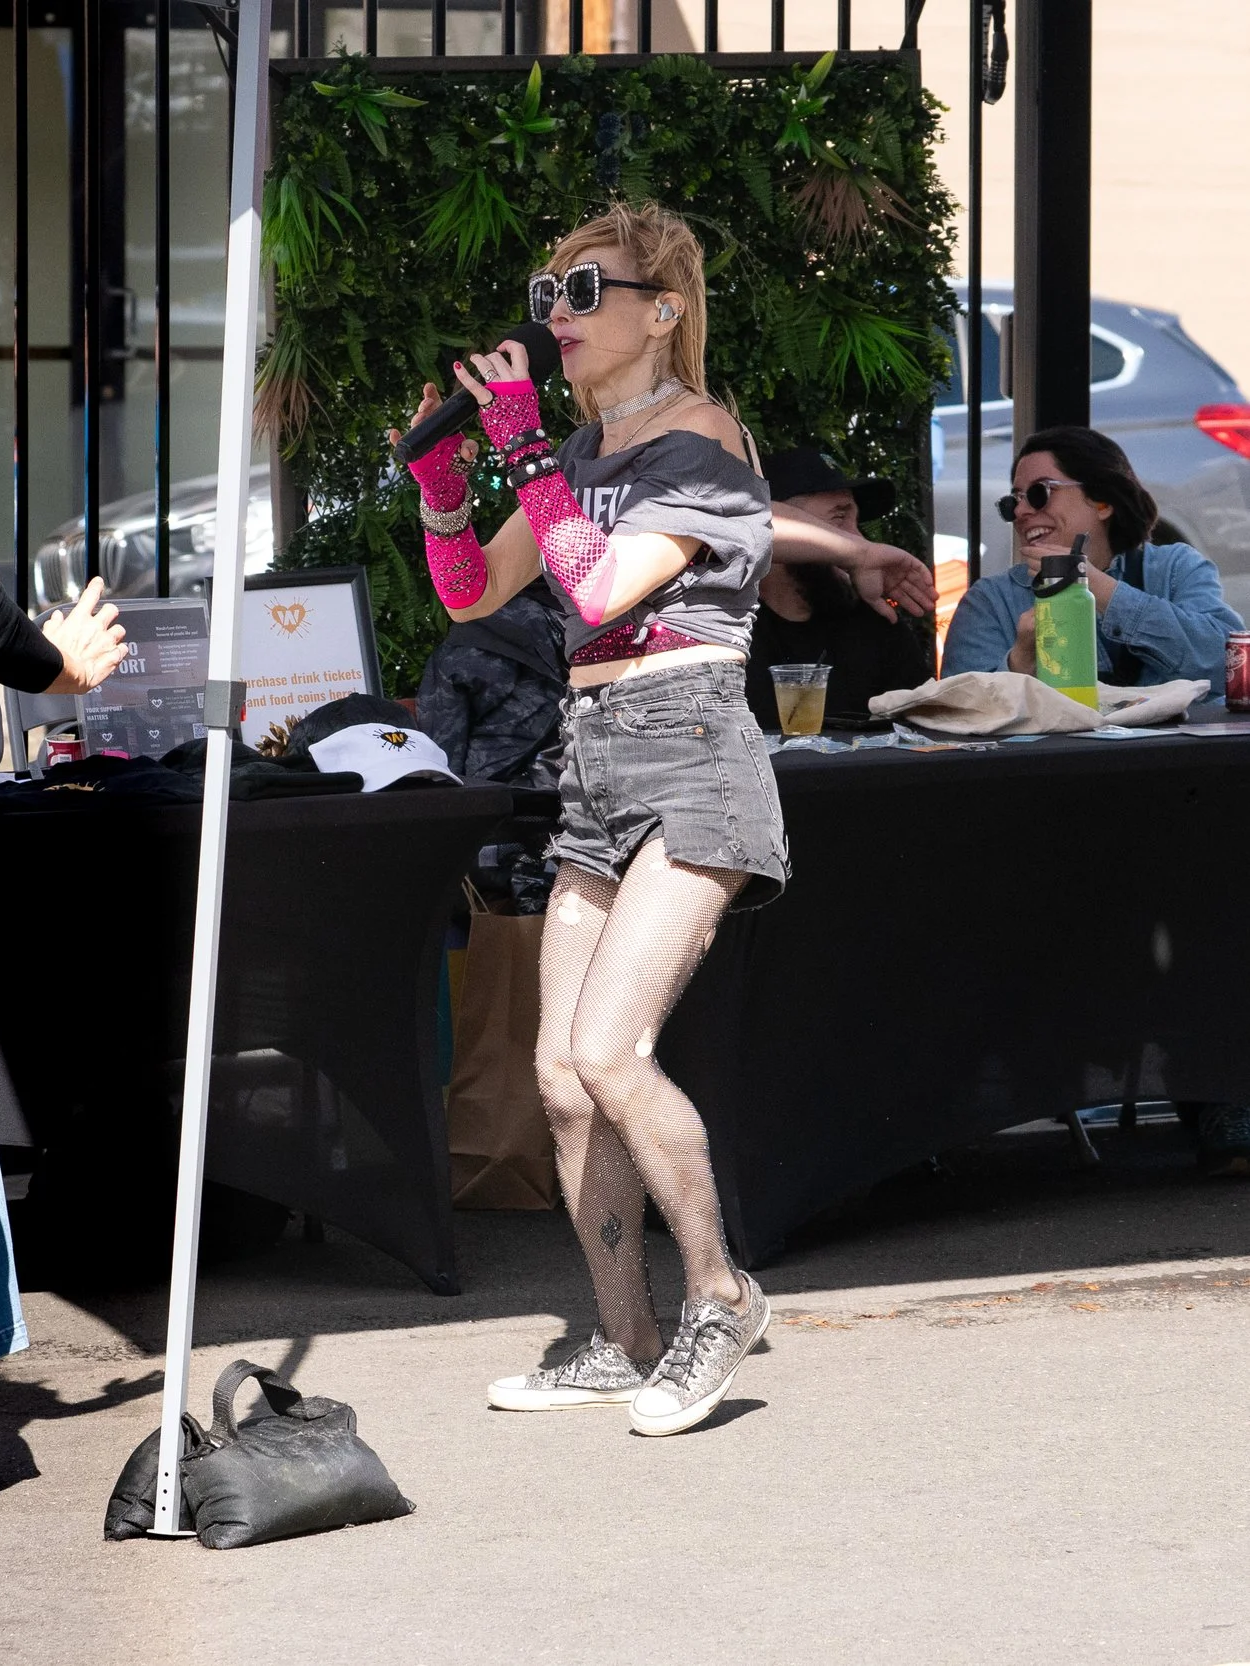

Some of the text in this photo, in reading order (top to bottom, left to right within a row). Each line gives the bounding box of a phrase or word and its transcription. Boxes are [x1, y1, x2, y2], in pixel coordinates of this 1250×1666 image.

[239, 669, 362, 689] urchase drink tickets
[247, 694, 267, 708] and
[270, 692, 294, 706] food
[297, 691, 327, 704] coins
